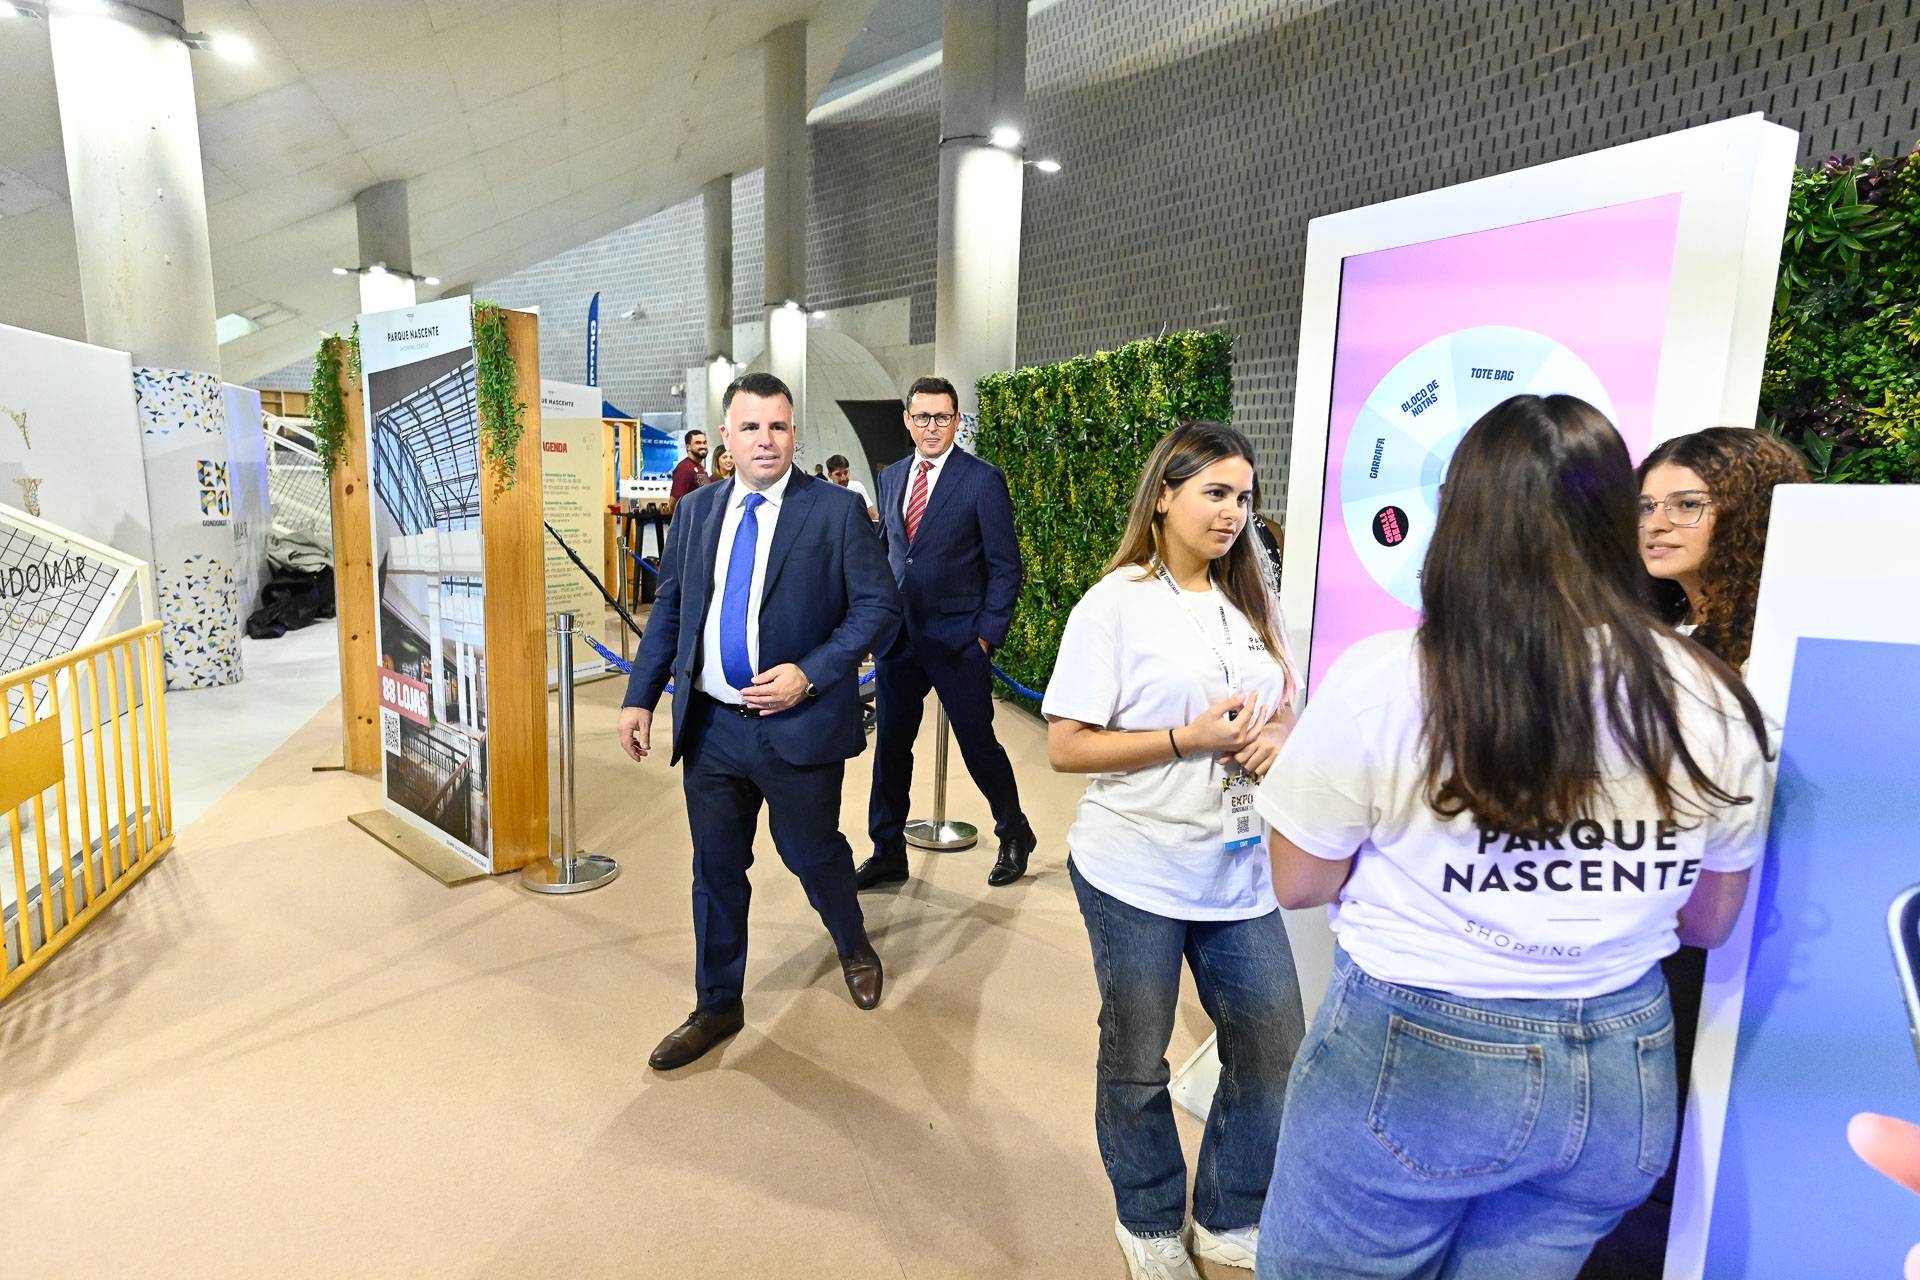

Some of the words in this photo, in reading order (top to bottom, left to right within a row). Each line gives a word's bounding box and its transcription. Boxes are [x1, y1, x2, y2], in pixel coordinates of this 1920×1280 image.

[387, 330, 409, 342] PARQUE
[410, 326, 439, 339] NASCENTE
[1471, 367, 1493, 380] TOTE
[1494, 369, 1514, 382] BAG
[548, 399, 574, 407] NASCENTE
[1401, 387, 1428, 413] BLOCO
[1426, 379, 1439, 393] DE
[1411, 393, 1438, 417] NOTAS
[1370, 437, 1385, 479] GARRAFA
[1386, 508, 1402, 542] BEANS
[382, 675, 396, 704] 88
[396, 681, 428, 718] LOJAS
[1231, 794, 1253, 807] EXPO
[1443, 858, 1702, 893] NASCENTE
[1464, 919, 1582, 958] SHOPPING
